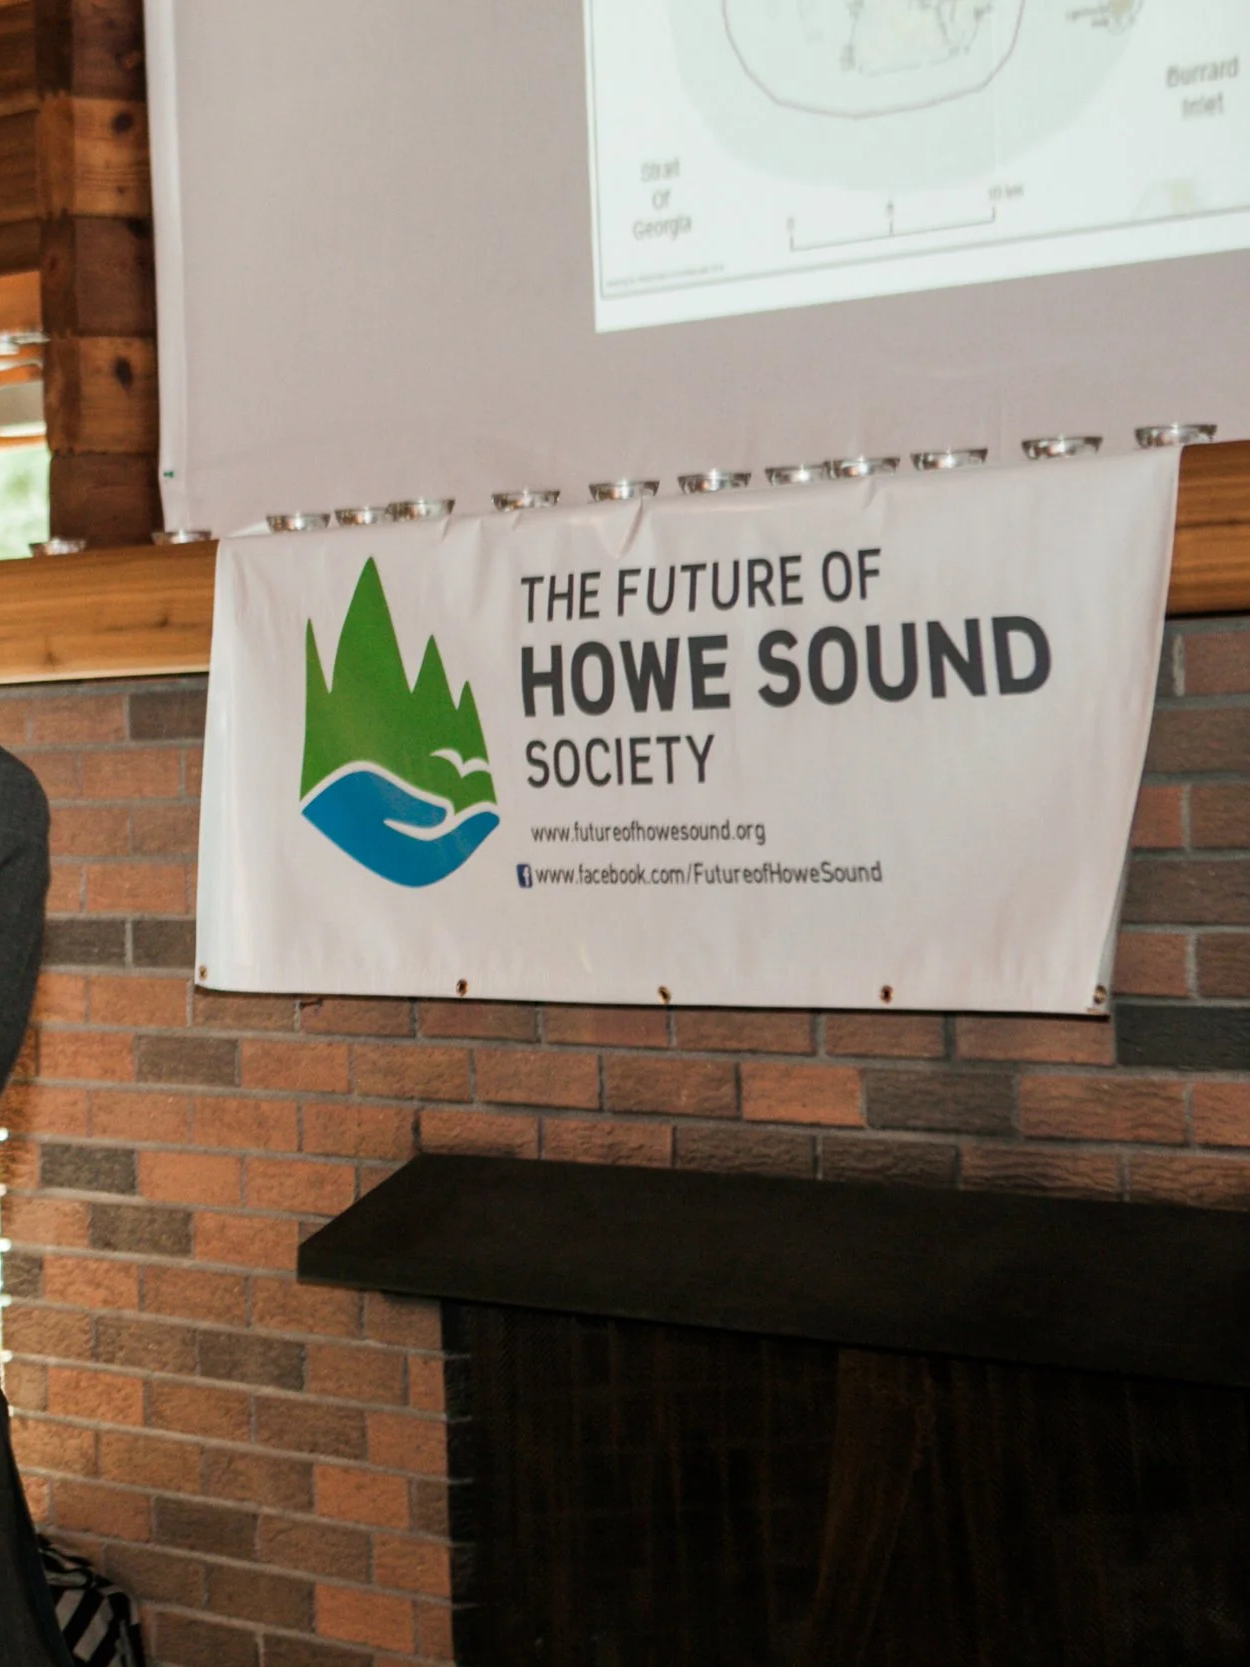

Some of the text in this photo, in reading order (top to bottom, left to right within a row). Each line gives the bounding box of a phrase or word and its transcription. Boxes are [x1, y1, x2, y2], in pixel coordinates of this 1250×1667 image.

[632, 215, 693, 241] Georgia
[520, 548, 882, 623] THE FUTURE OF
[520, 616, 1051, 717] HOWE SOUND
[525, 734, 715, 788] SOCIETY
[531, 820, 766, 846] www.futureofhowesound.org
[536, 861, 883, 885] www.facebook.com/FutureofHoweSound
